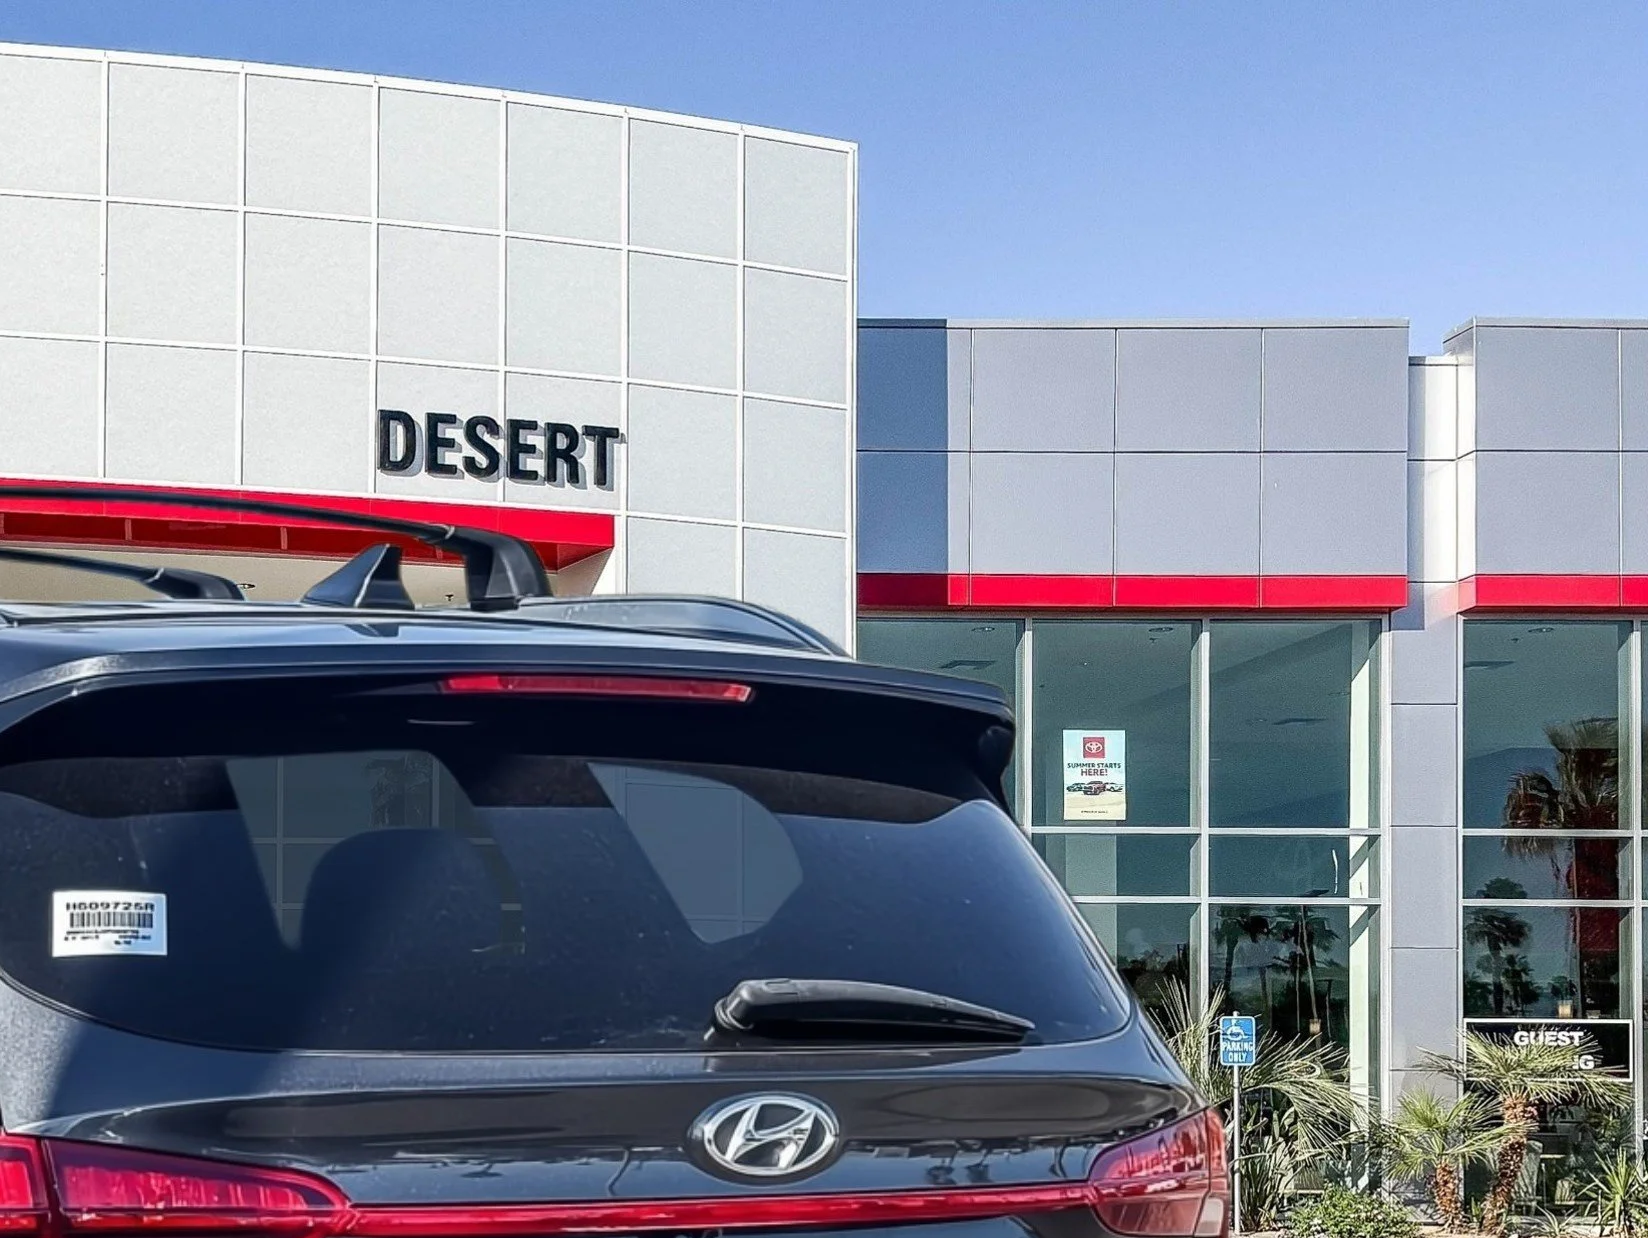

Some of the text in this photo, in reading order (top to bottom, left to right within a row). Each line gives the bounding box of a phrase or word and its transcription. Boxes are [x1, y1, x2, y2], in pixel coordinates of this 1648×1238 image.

[376, 408, 621, 486] DESERT
[1080, 768, 1108, 776] HERE!
[1513, 1030, 1584, 1047] GUEST
[1222, 1041, 1254, 1051] PARKING
[1228, 1052, 1248, 1062] ONLY
